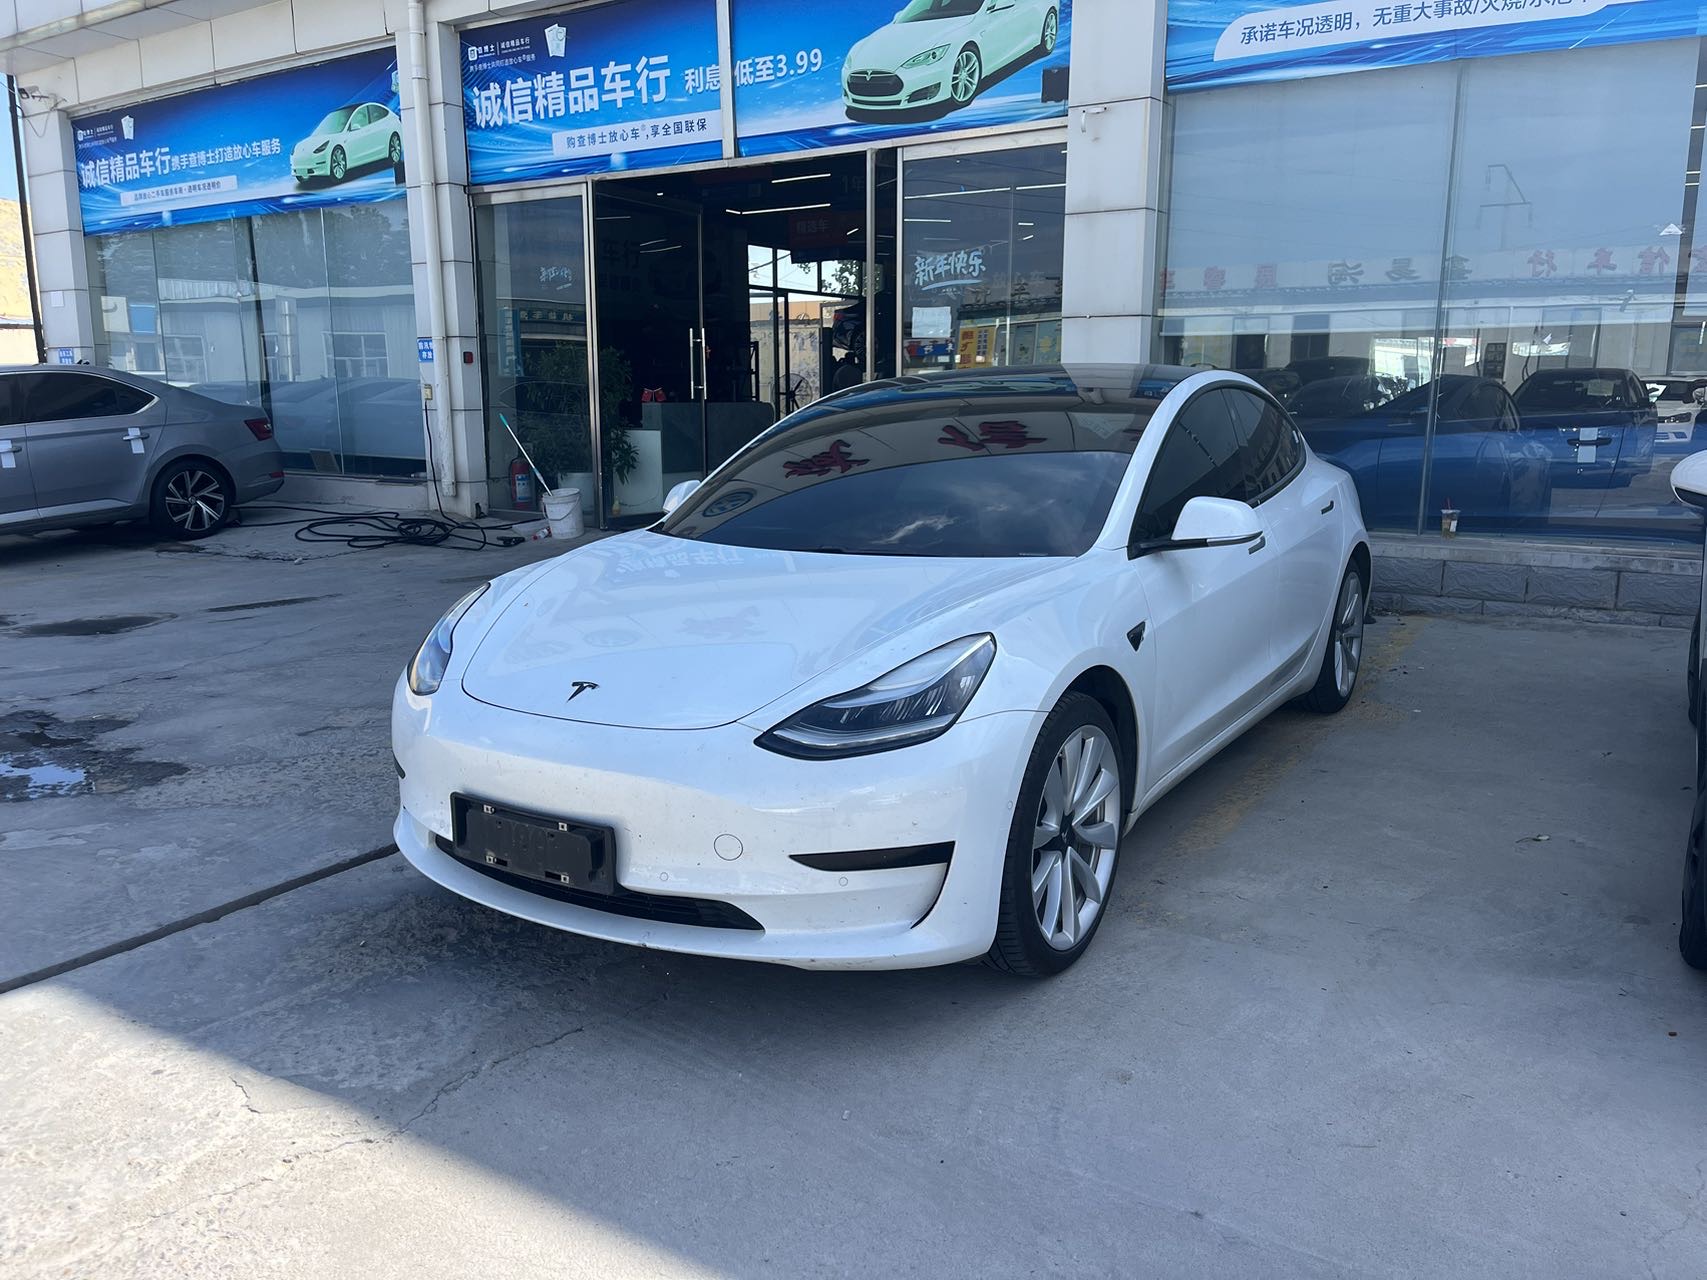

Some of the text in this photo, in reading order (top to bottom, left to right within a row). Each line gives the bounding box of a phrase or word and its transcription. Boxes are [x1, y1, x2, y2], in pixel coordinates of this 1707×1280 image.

[473, 55, 670, 127] 诚信精品车行
[735, 48, 823, 87] 低至3.99
[80, 137, 281, 187] 诚信精品车行 携手查博士打造放心车服务
[913, 247, 988, 287] 新年快乐
